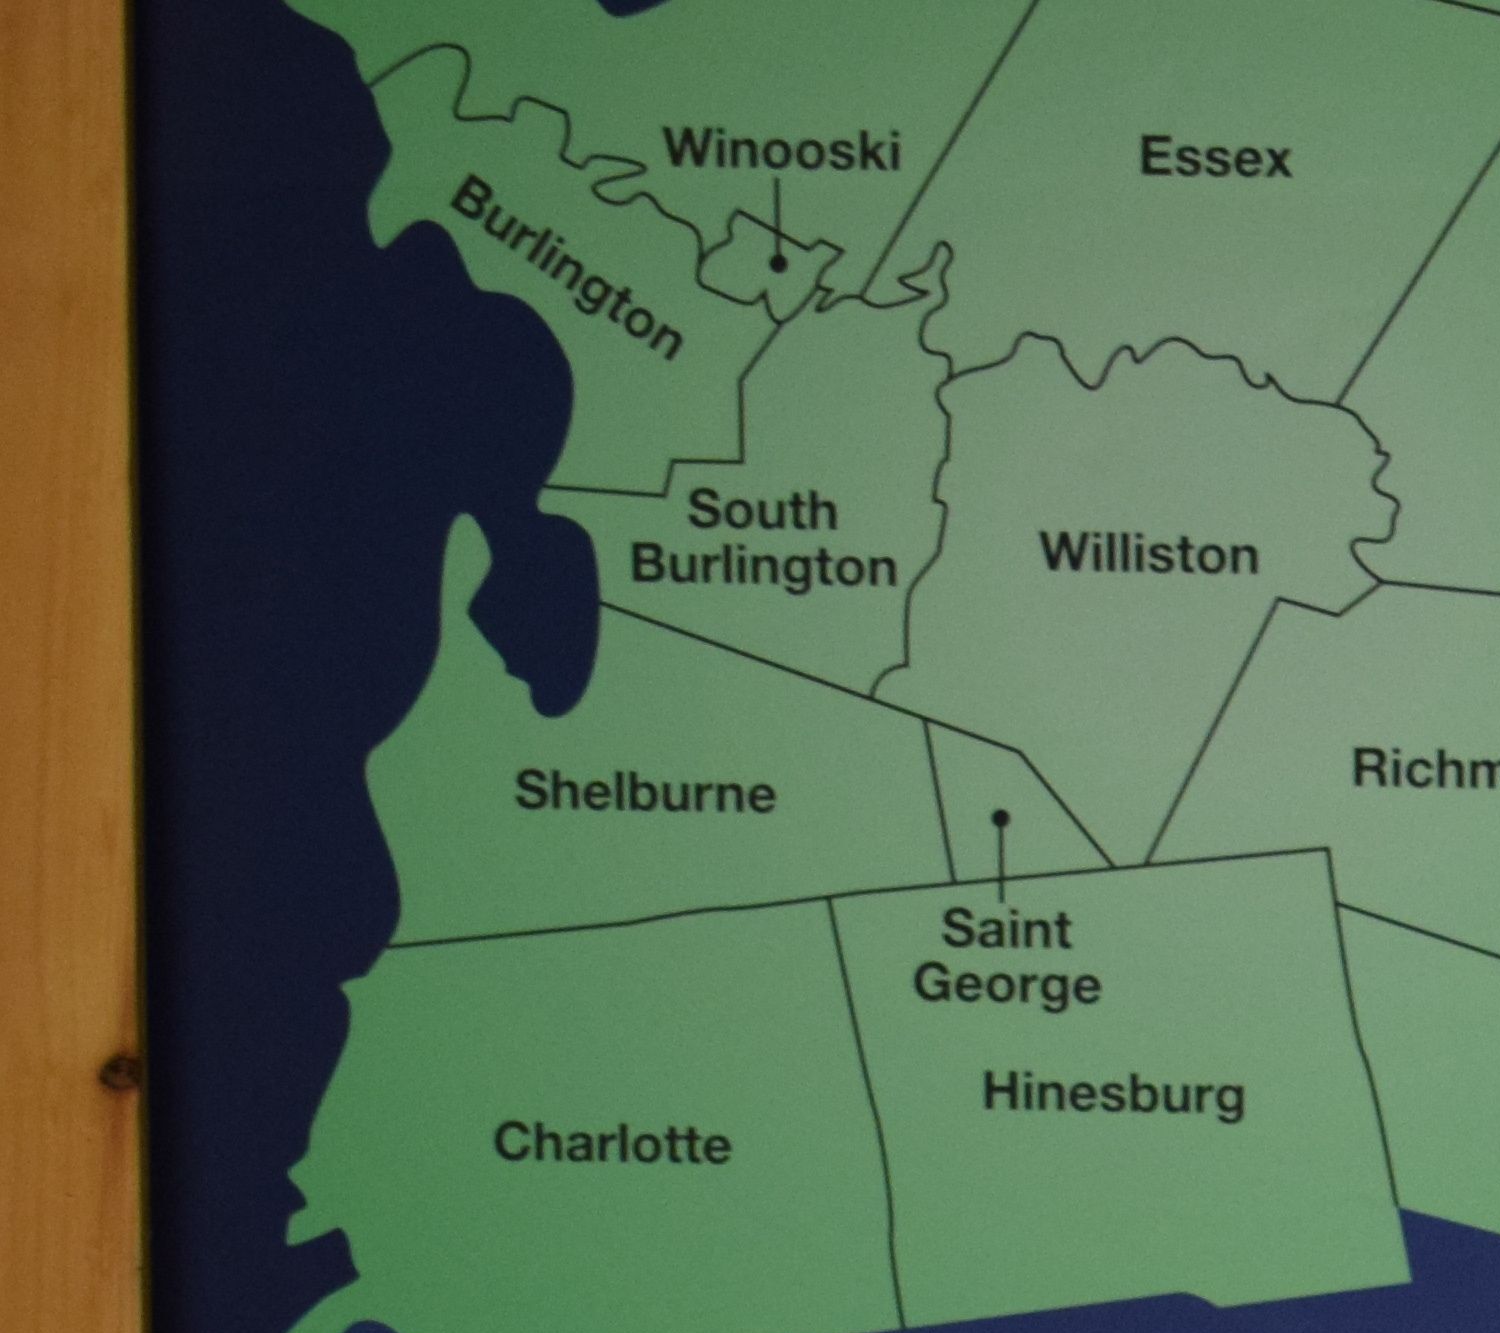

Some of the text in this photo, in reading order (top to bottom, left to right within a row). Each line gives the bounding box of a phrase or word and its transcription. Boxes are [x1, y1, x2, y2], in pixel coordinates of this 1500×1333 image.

[661, 125, 901, 172] Winooski
[1139, 133, 1293, 179] Essex
[449, 174, 685, 361] Burlington
[687, 486, 838, 531] South
[630, 540, 898, 595] Burlington
[1038, 530, 1259, 575] Williston
[514, 767, 777, 815] Shelburne
[941, 907, 1073, 950] Saint
[912, 959, 1103, 1014] George
[982, 1069, 1246, 1125] Hinesburg
[492, 1118, 733, 1166] Charlotte
